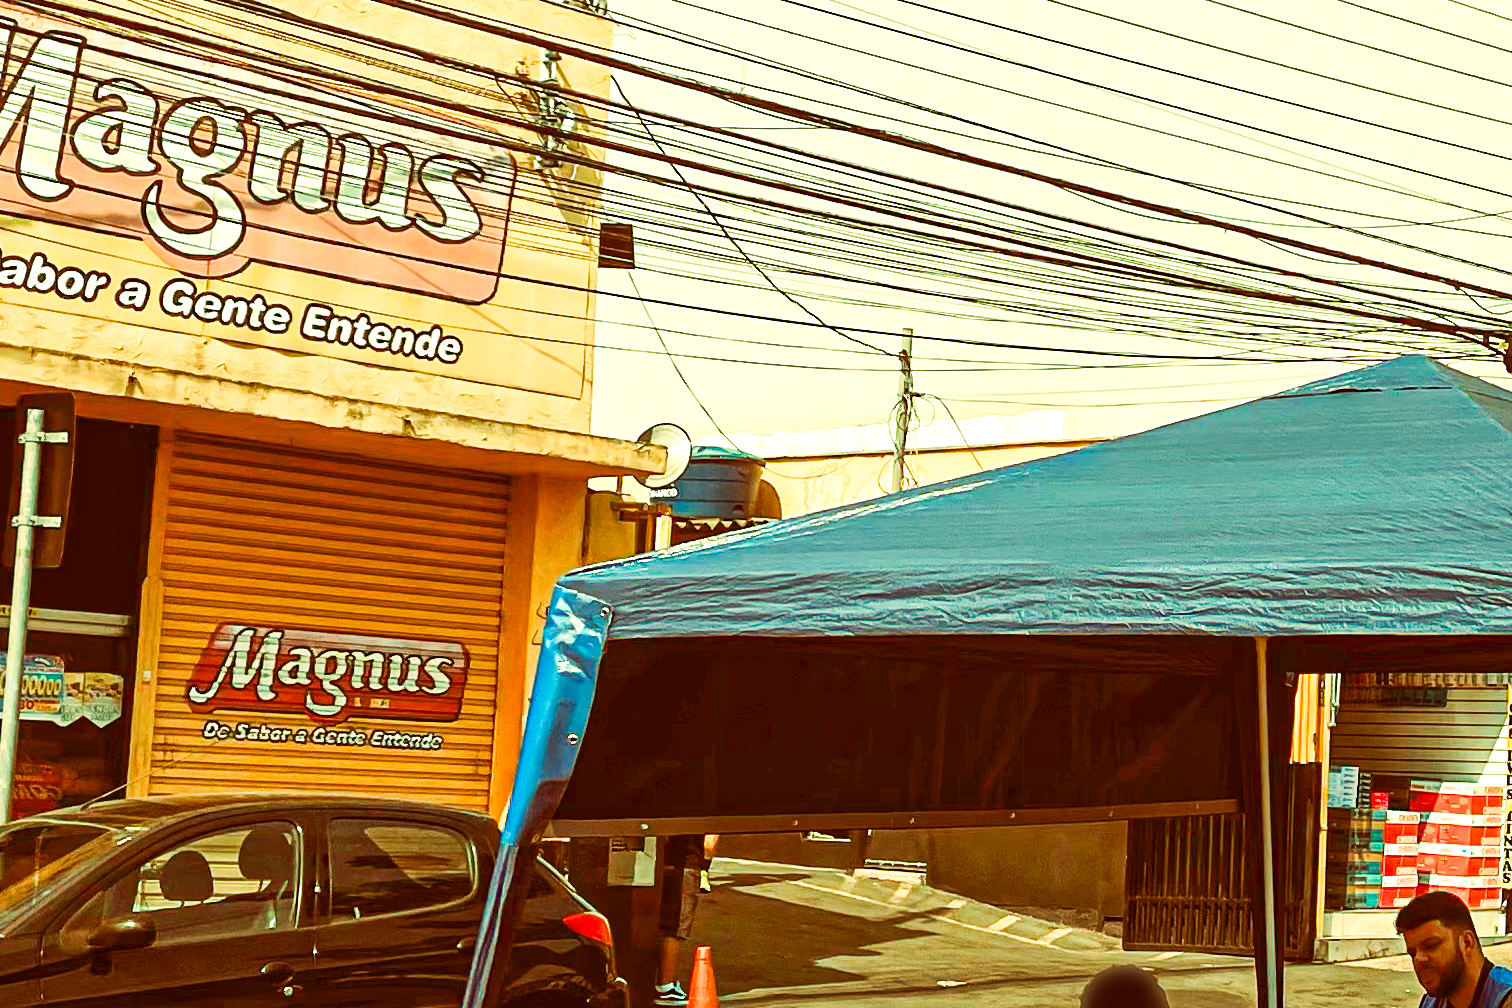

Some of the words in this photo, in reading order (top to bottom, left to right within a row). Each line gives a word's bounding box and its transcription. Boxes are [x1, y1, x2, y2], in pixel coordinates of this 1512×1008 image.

[0, 252, 111, 302] abor
[115, 278, 150, 311] a
[162, 276, 292, 335] Gente
[301, 305, 464, 364] Entende
[187, 627, 456, 716] Magnus
[203, 721, 230, 739] De
[235, 723, 291, 743] Sabor
[295, 728, 307, 743] a
[312, 727, 367, 746] Gente
[371, 730, 444, 750] Entende
